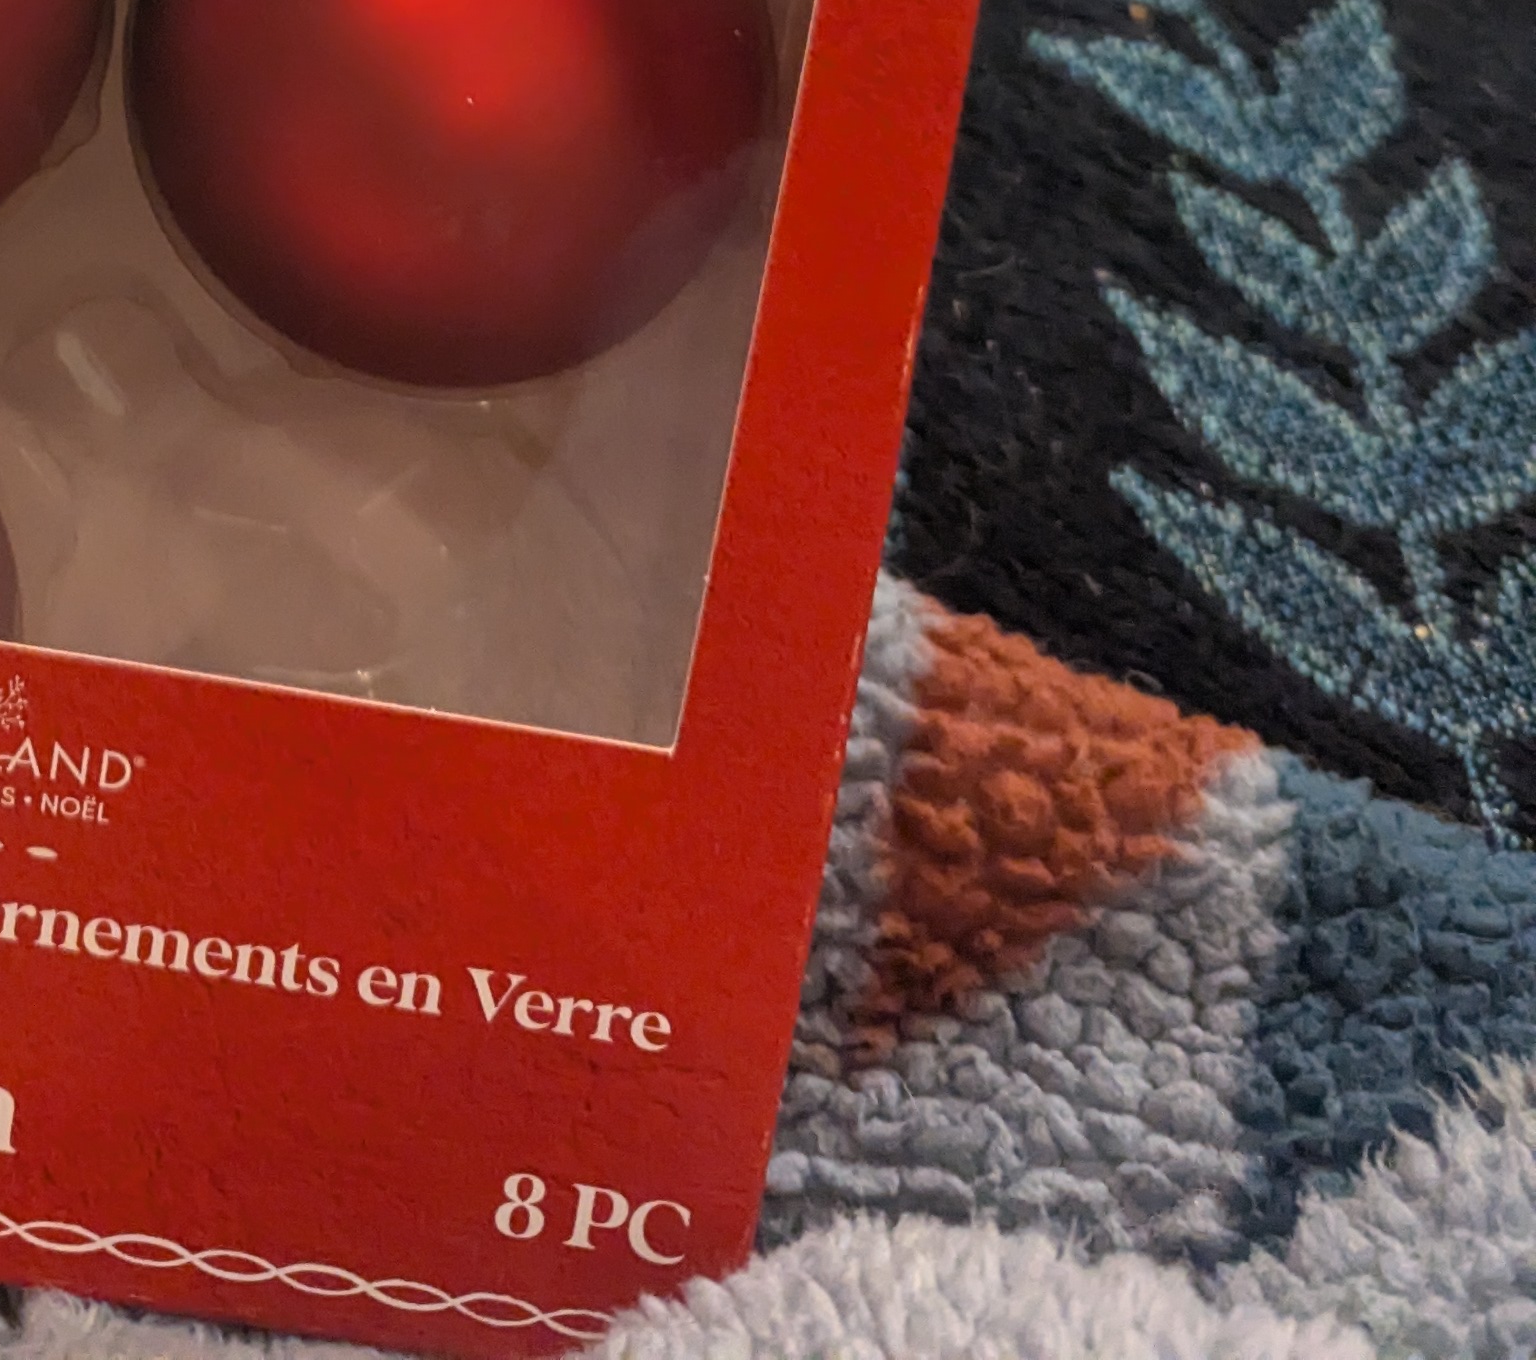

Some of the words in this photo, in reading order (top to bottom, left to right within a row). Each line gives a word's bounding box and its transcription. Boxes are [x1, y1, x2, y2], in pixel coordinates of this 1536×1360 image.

[40, 791, 110, 825] NOËL
[357, 964, 442, 1016] en
[466, 966, 672, 1053] Verre
[494, 1172, 547, 1240] 8
[562, 1183, 692, 1265] PC
